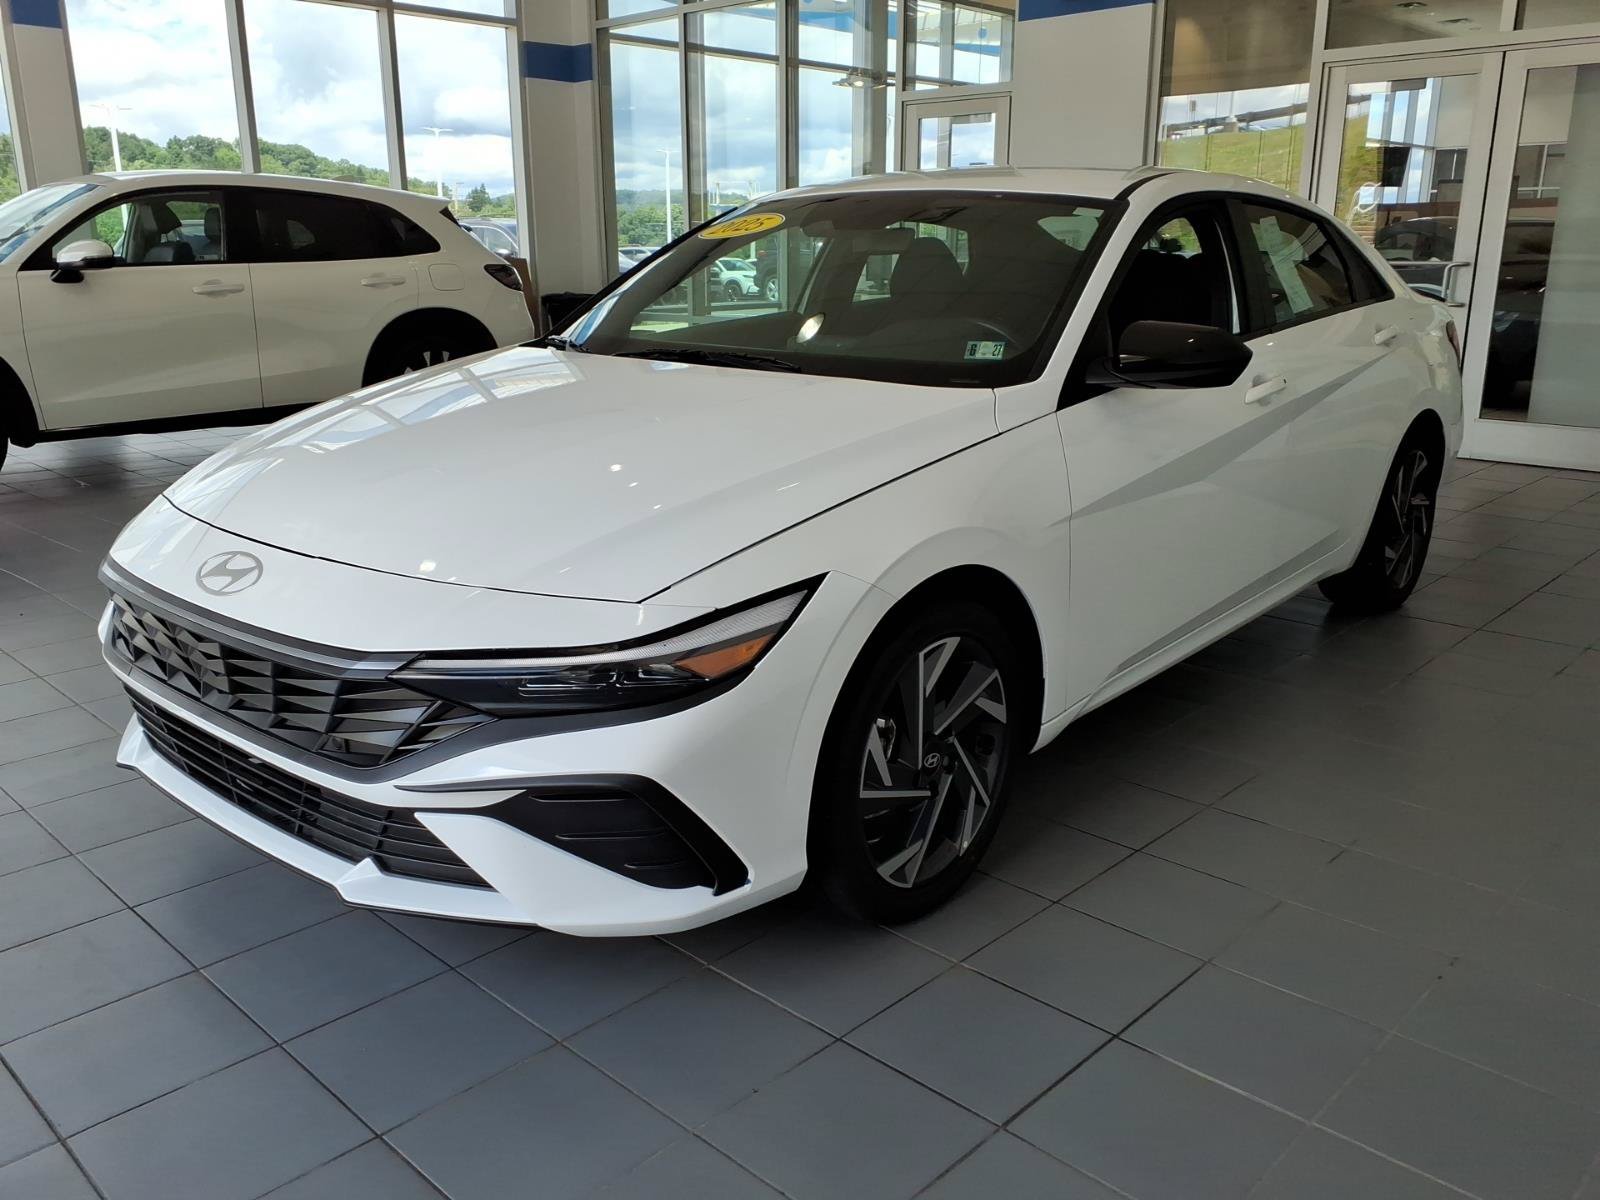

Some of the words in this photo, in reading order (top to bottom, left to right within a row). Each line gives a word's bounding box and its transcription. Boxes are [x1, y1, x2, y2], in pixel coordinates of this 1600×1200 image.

[705, 217, 776, 235] 2025
[969, 343, 978, 357] 6
[992, 343, 1003, 357] 27
